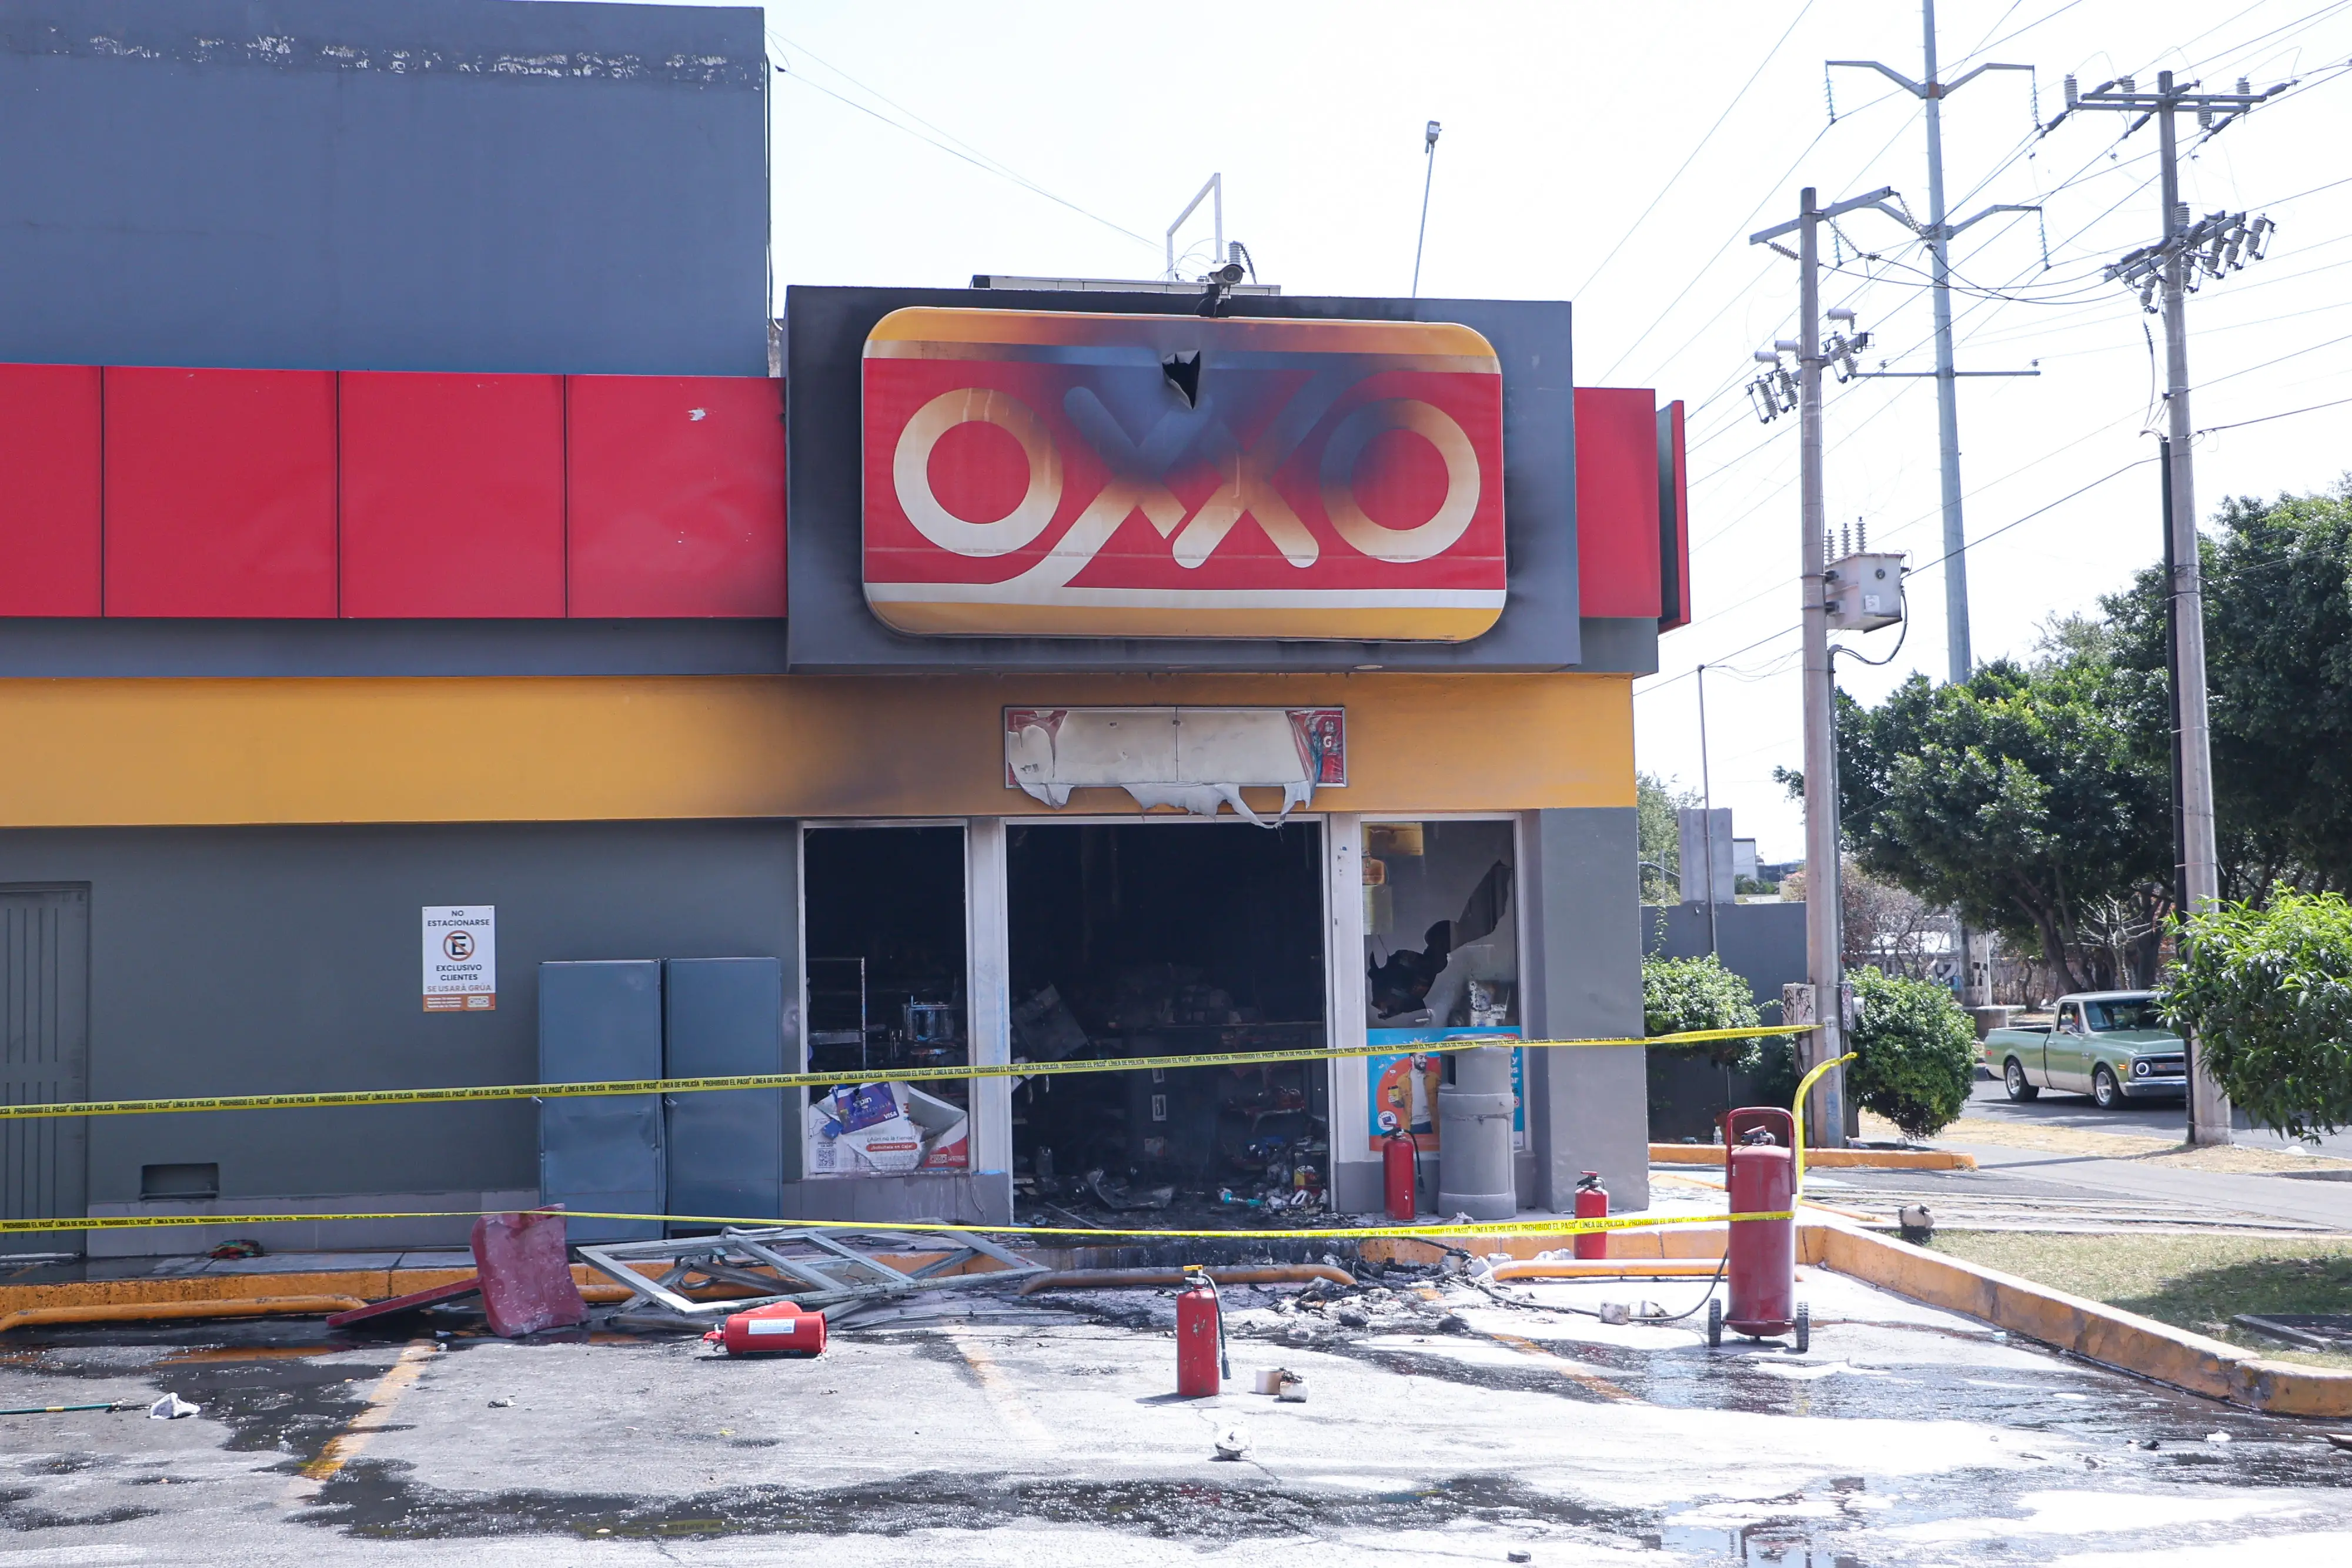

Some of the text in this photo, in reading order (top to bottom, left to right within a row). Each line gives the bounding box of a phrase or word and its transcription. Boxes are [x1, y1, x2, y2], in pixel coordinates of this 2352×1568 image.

[893, 385, 1480, 579] OXXO
[1323, 735, 1331, 748] G
[452, 936, 467, 955] E
[416, 1091, 444, 1099] PROHIBIDO
[884, 1111, 897, 1119] VISA
